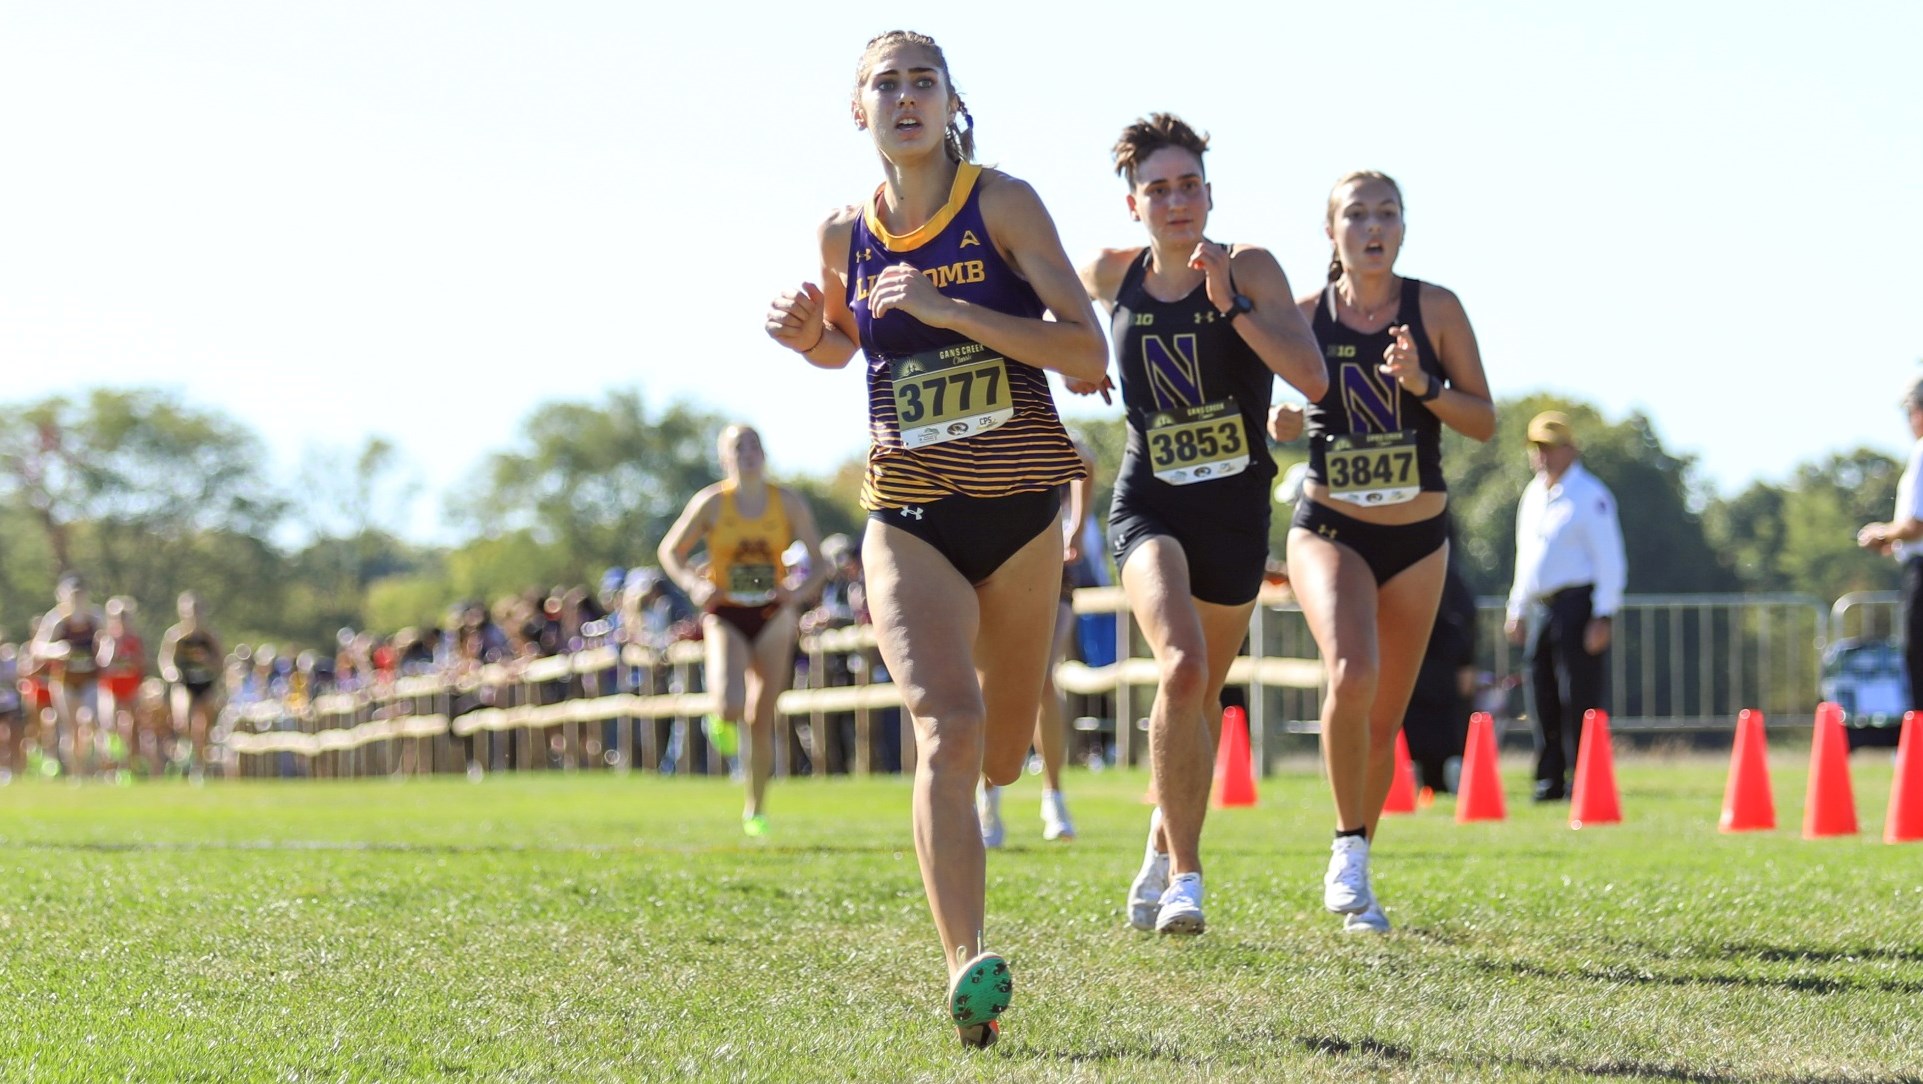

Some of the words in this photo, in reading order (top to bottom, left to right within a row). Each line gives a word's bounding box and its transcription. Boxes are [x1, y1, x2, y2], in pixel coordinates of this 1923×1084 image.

[856, 260, 985, 301] LIOMB
[940, 347, 960, 359] GANS
[1142, 333, 1205, 411] N
[899, 366, 1000, 422] 3777
[1340, 363, 1402, 433] N
[1152, 422, 1241, 465] 3853
[1331, 453, 1413, 487] 3847
